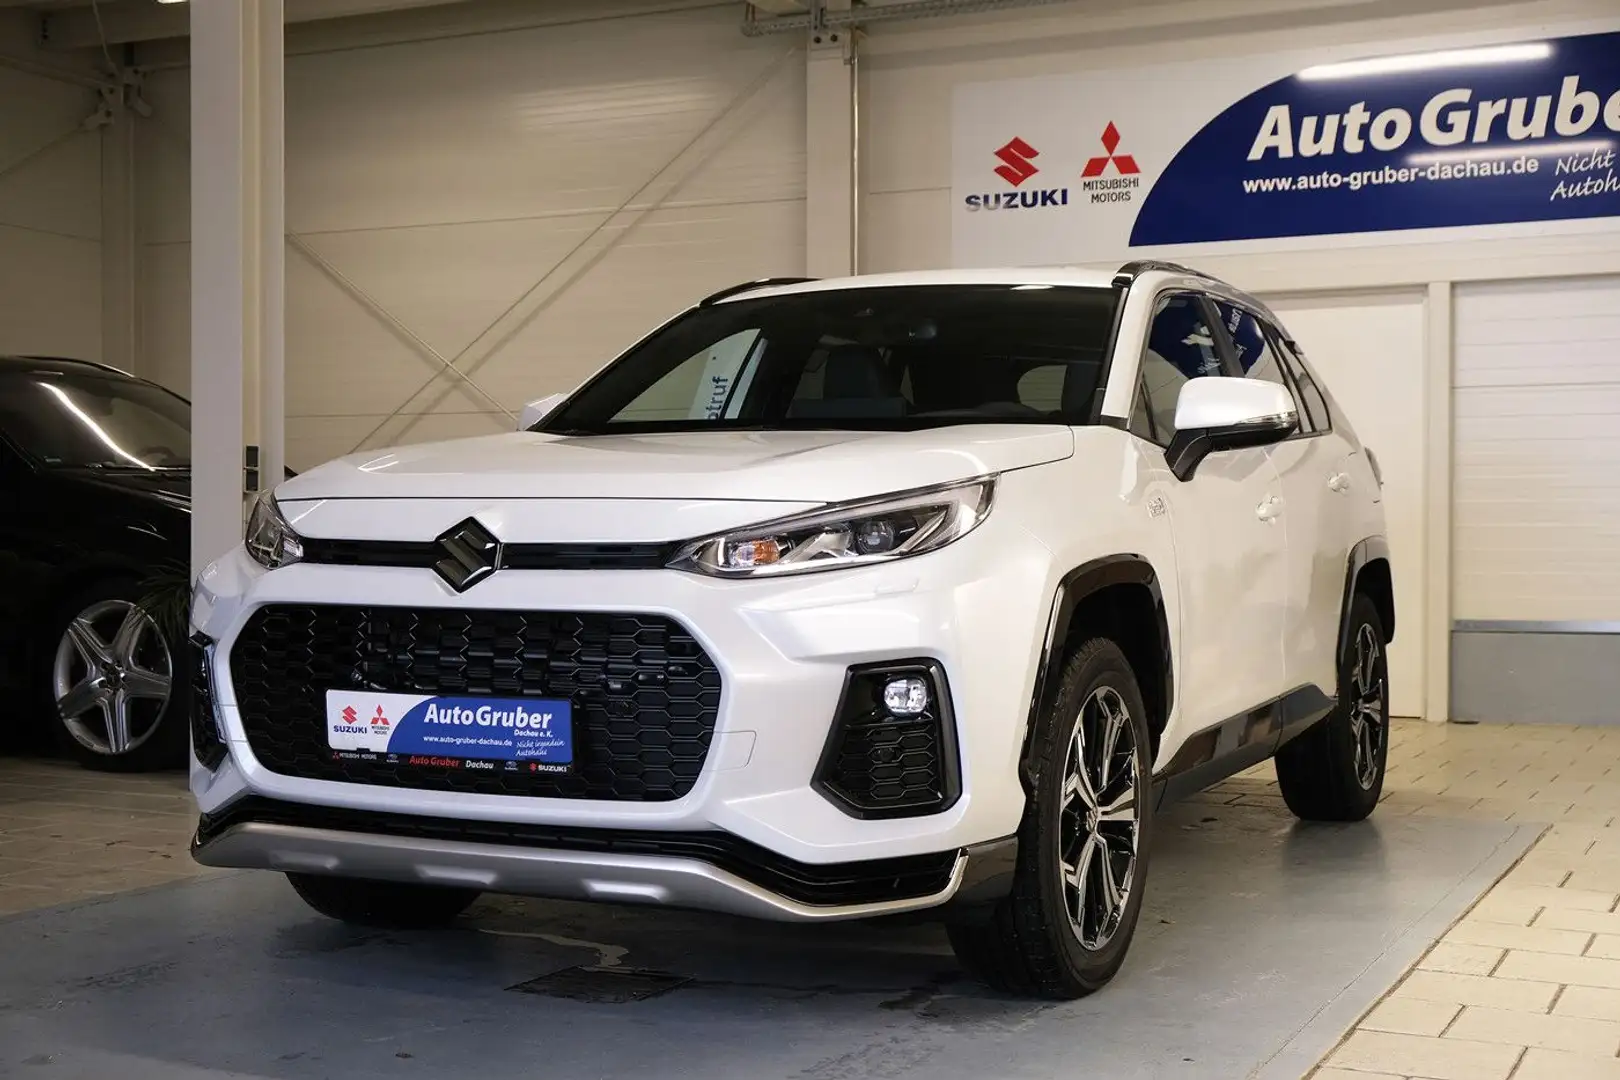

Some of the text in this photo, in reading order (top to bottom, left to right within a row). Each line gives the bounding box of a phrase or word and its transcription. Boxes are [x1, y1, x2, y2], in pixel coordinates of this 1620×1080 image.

[1555, 147, 1616, 176] Nicht
[1243, 156, 1539, 193] www.auto-gruber-dachau.de
[1083, 177, 1139, 191] MITSUBISHI
[965, 188, 1068, 212] SUZUKI
[1091, 191, 1132, 203] MOTORS
[333, 724, 367, 734] SUZUKI
[423, 735, 513, 747] www.auto-gruber-dachau.de
[409, 755, 494, 769] Auto Gruber Dachau
[538, 764, 568, 772] SUZUKI
